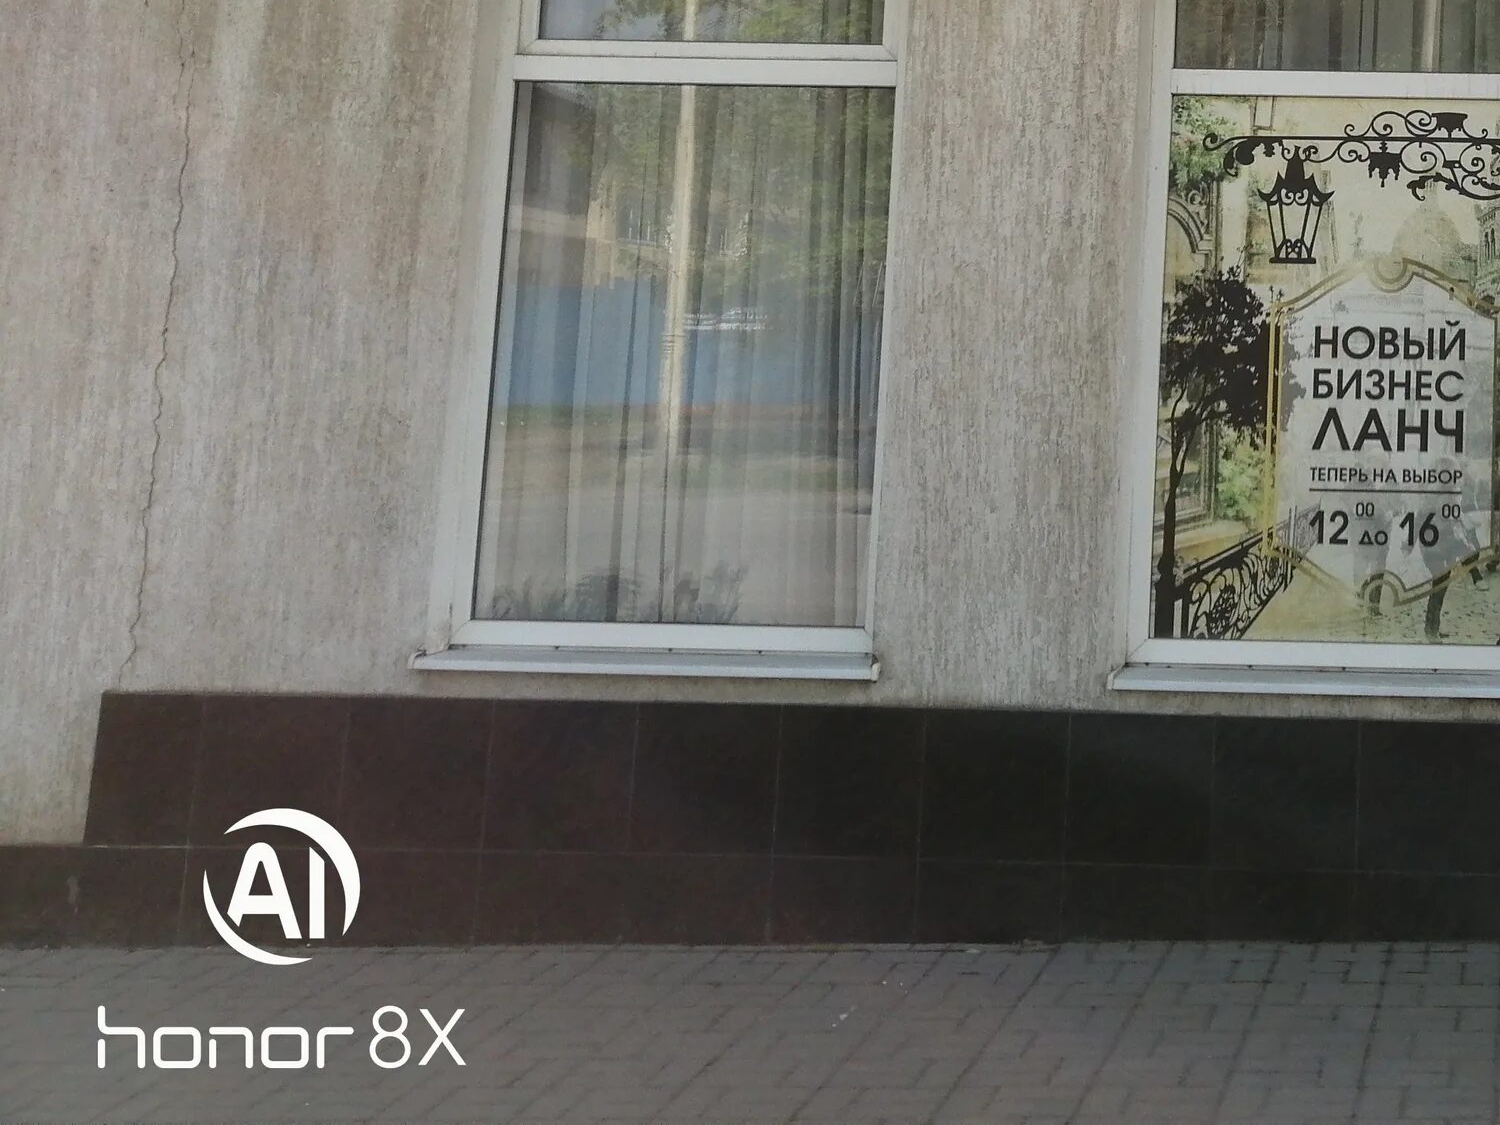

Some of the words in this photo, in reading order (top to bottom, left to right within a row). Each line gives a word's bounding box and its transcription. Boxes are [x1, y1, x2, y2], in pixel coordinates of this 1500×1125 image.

[1313, 320, 1466, 361] НОВЫЙ
[1312, 369, 1464, 402] БИЗНЕС
[1312, 407, 1464, 453] ЛАНЧ
[1310, 467, 1368, 483] ТЕПЕРЬ
[1372, 468, 1397, 483] НА
[1402, 469, 1463, 485] ВЫБОР
